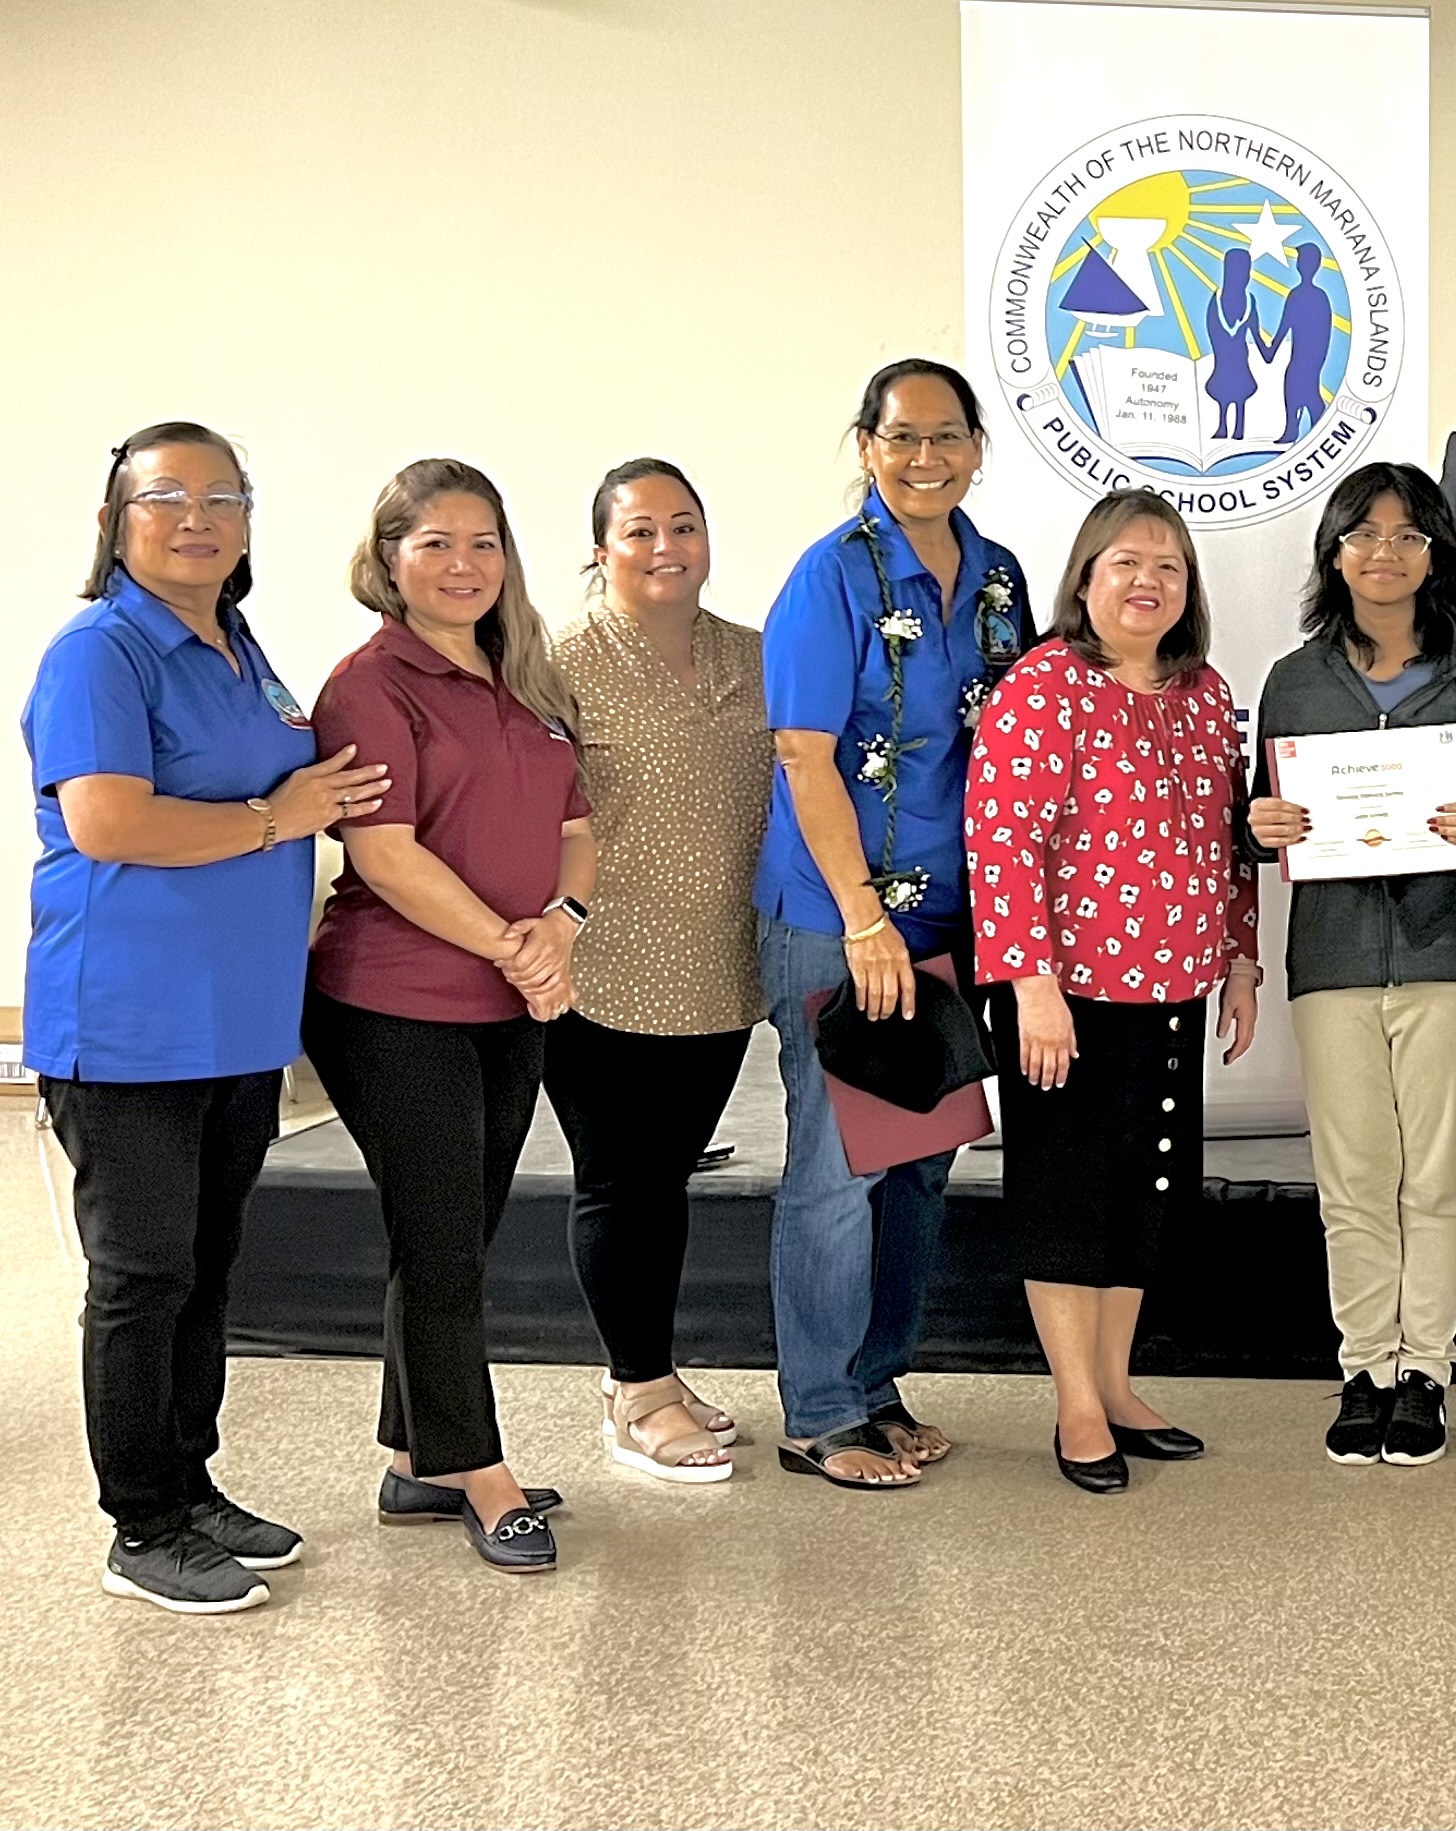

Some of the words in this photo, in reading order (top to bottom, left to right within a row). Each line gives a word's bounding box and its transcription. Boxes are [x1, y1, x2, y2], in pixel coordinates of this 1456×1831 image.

[1006, 174, 1086, 373] COMMONWEALTH
[1085, 149, 1115, 179] OF
[1120, 132, 1171, 162] THE
[1178, 130, 1312, 187] NORTHERN
[1310, 179, 1381, 282] MARIANA
[1363, 285, 1389, 388] ISLANDS
[1131, 367, 1178, 382] Founded
[1141, 383, 1167, 393] 1947
[1125, 396, 1180, 412] Autonomy
[1042, 416, 1131, 491] PUBLIC
[1262, 420, 1356, 500] SYSTEM
